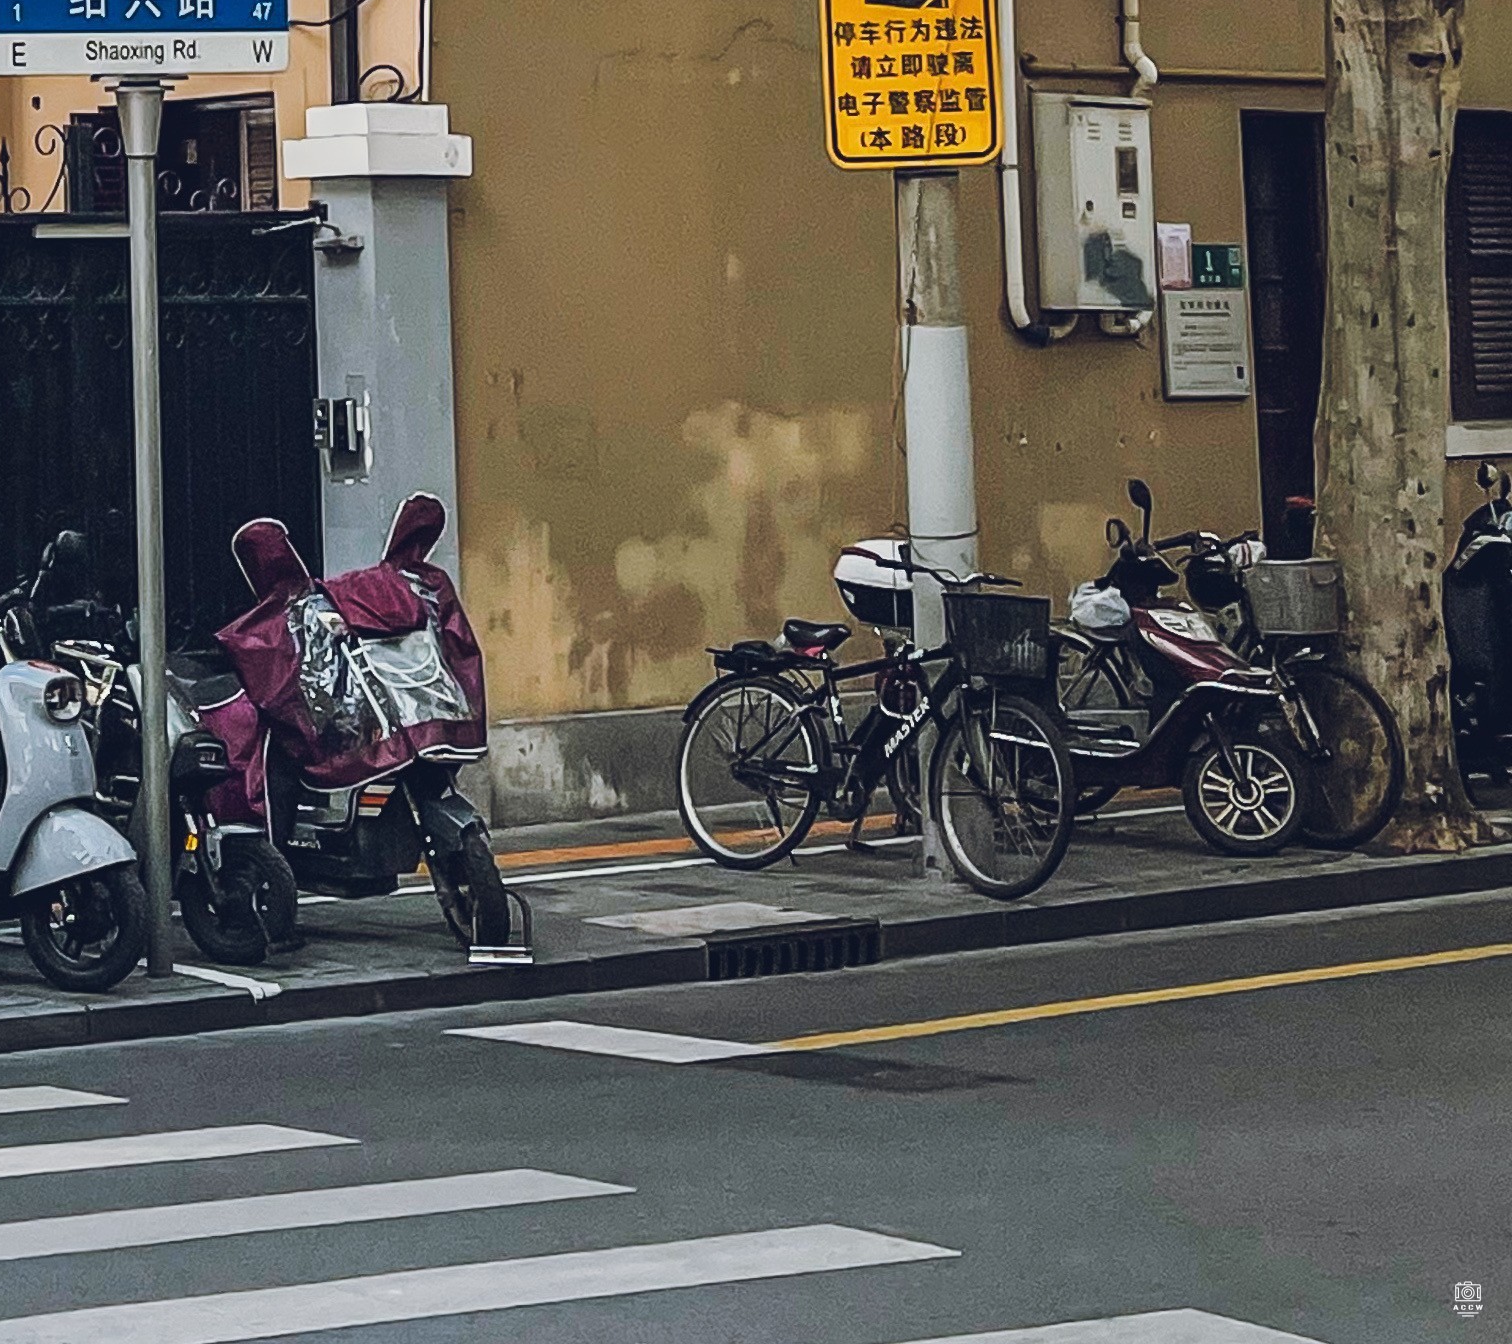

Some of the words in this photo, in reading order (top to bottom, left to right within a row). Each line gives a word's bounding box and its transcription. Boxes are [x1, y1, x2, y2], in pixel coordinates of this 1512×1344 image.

[13, 3, 21, 22] 1
[252, 2, 272, 21] 47
[834, 15, 983, 47] 停车行为违法
[12, 41, 27, 67] E
[85, 40, 165, 65] Shaoxing
[252, 39, 273, 63] W
[851, 51, 974, 79] 请立即驶离
[838, 87, 986, 117] 电子警察监管
[884, 696, 930, 758] MASTER
